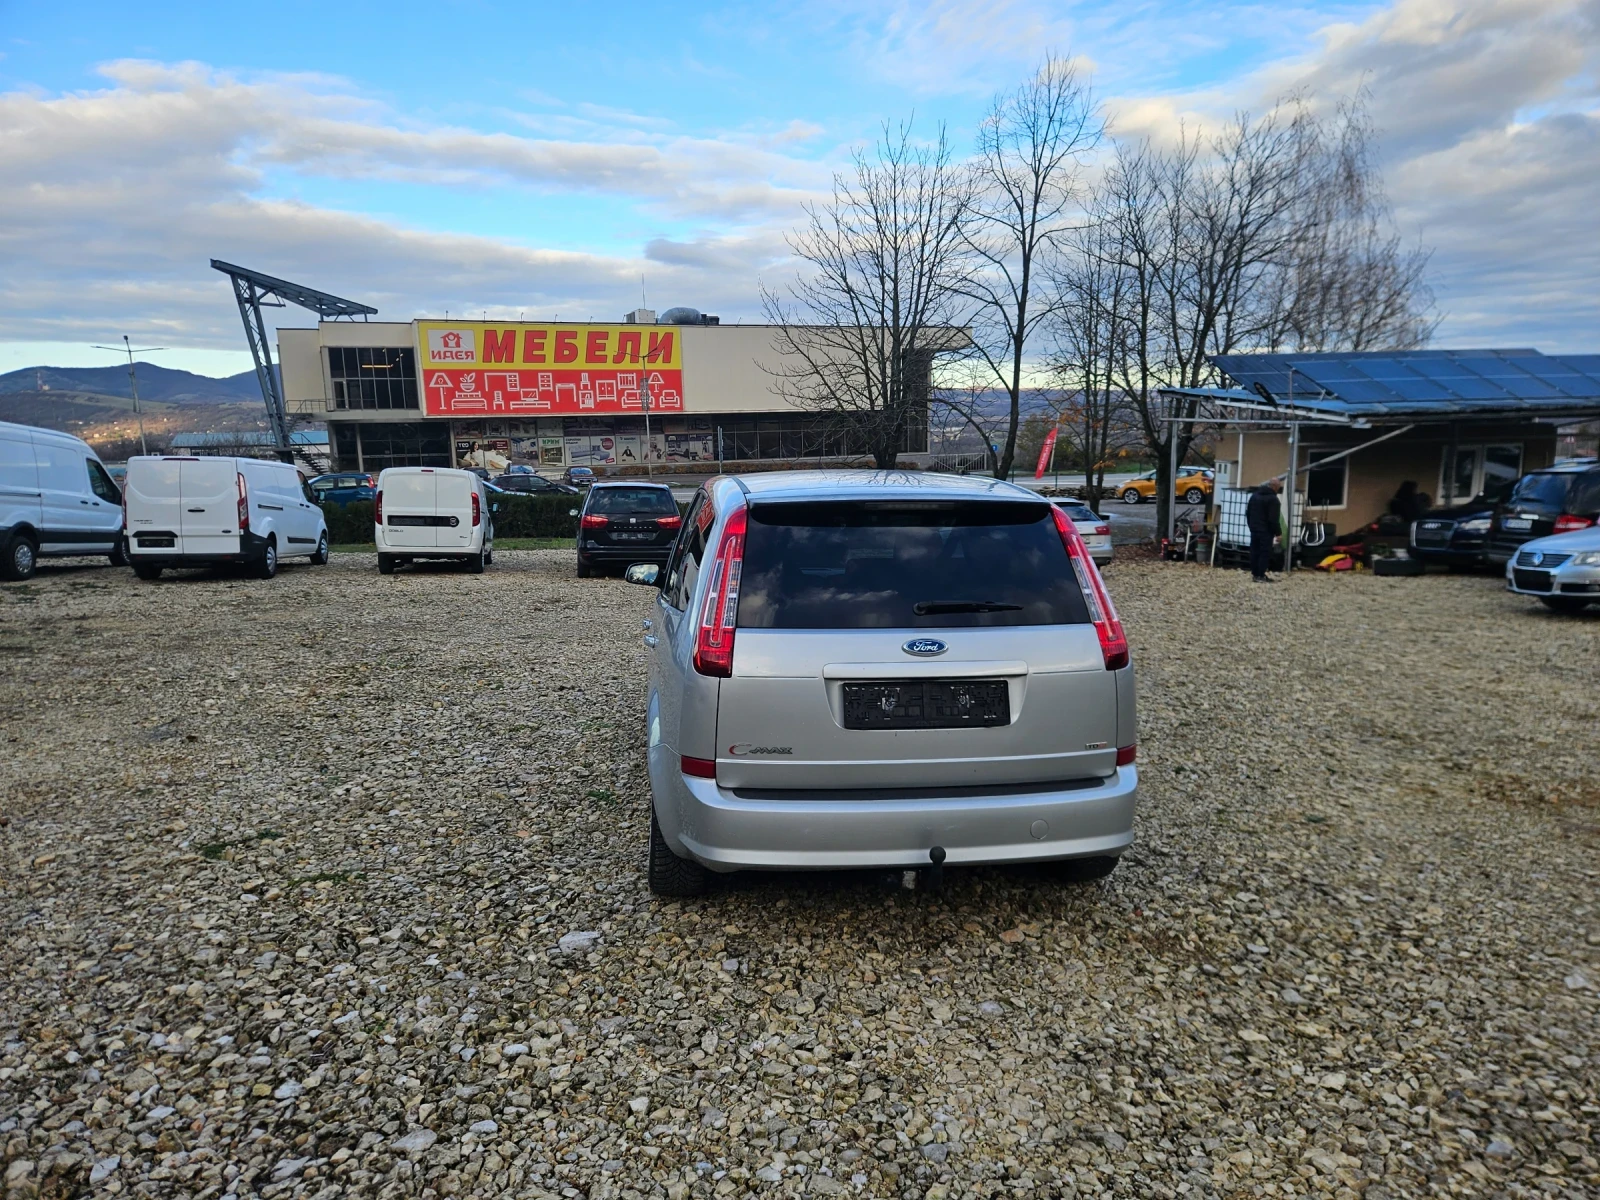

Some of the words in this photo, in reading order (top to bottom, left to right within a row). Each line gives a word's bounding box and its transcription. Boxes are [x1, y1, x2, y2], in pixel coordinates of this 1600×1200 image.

[482, 329, 674, 364] МЕБЕЛИ
[431, 350, 475, 360] ИДЕЯ
[913, 640, 939, 651] Ford
